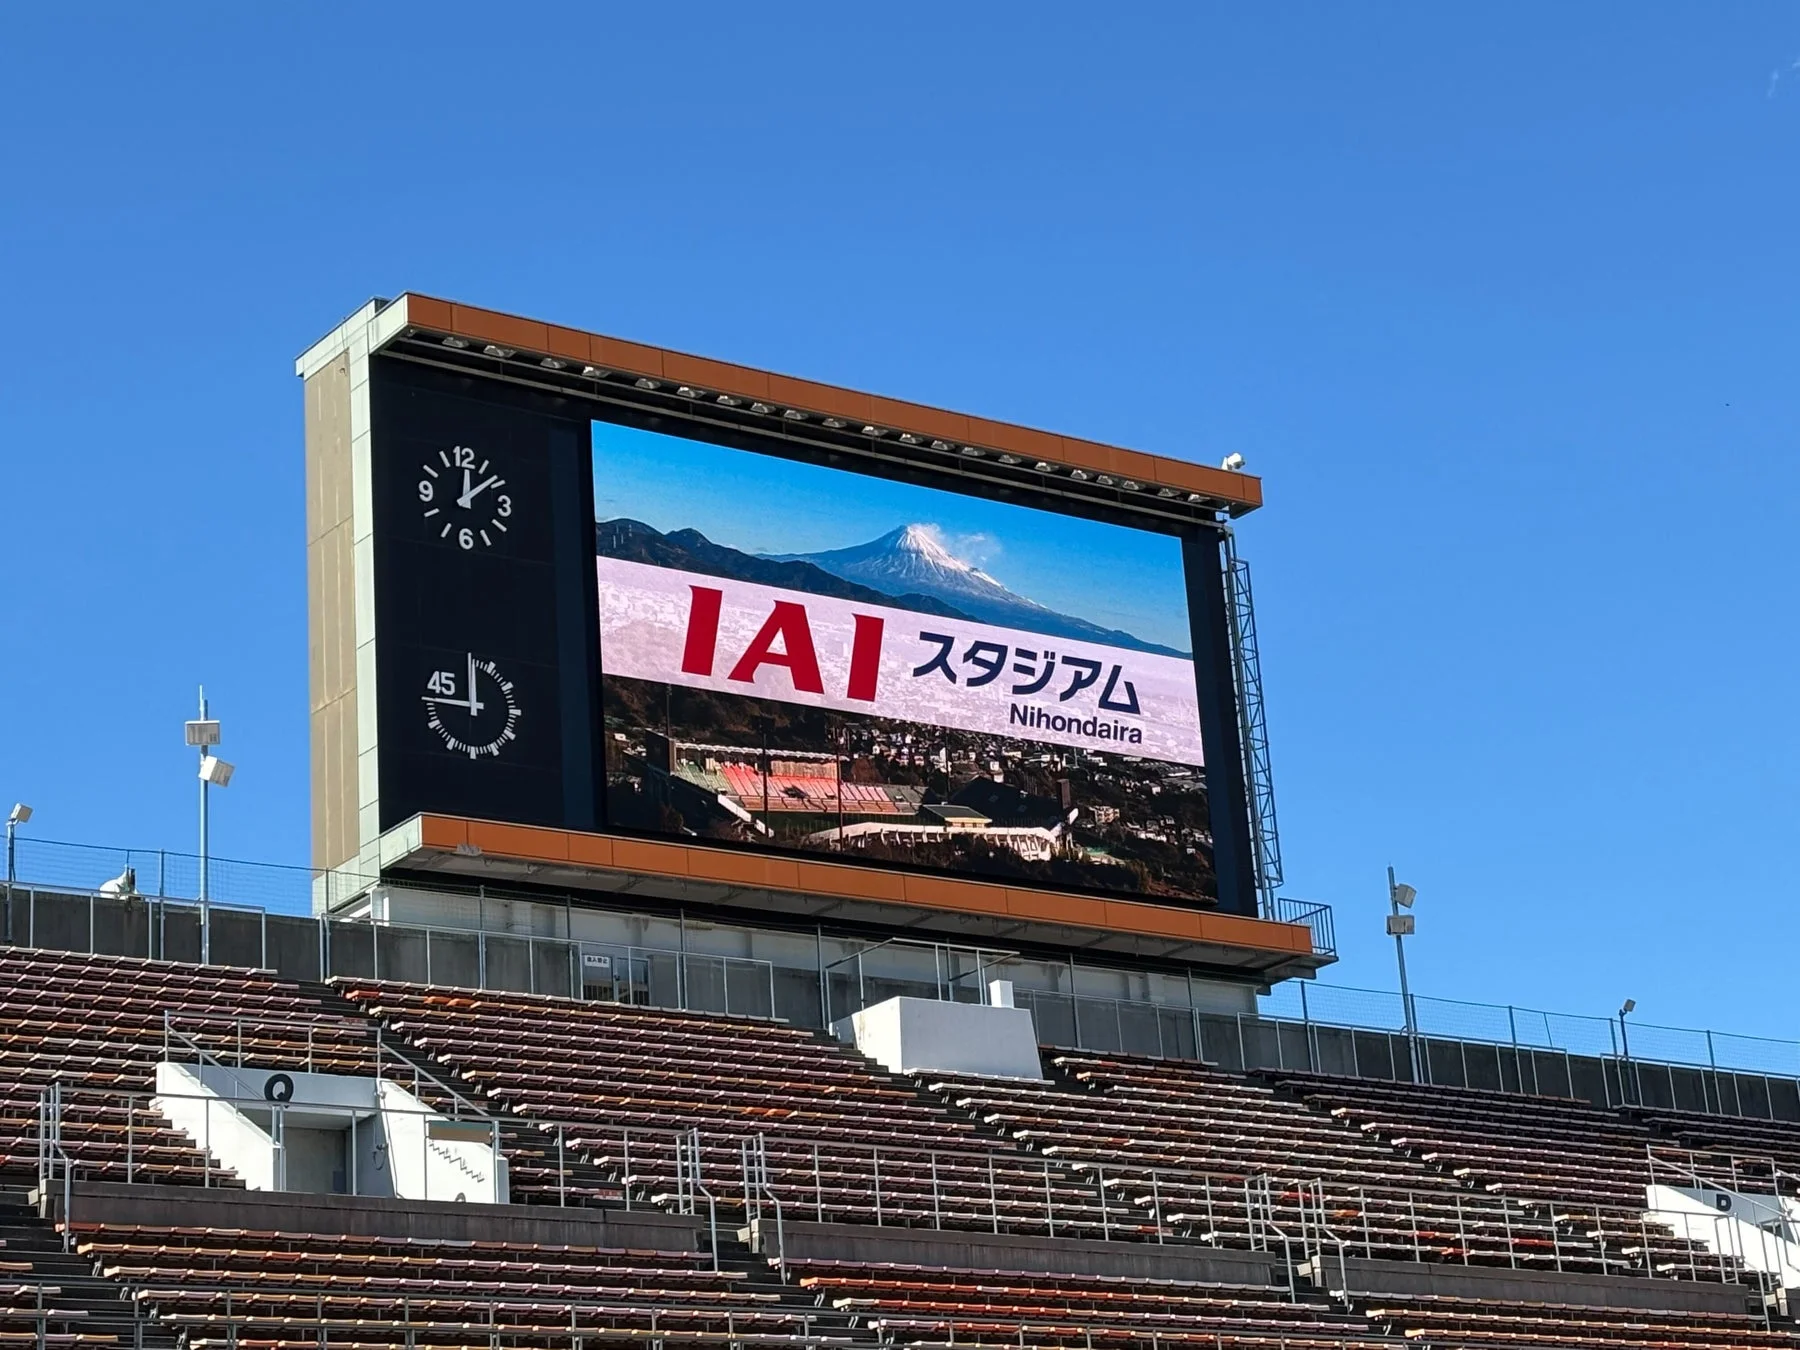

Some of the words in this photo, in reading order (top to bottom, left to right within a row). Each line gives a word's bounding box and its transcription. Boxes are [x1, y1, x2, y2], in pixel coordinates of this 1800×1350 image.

[453, 446, 476, 469] 12
[418, 480, 434, 502] 9
[497, 495, 512, 517] 3
[458, 528, 474, 550] 6
[681, 585, 884, 702] IAI
[912, 631, 1141, 715] スタジアム
[427, 671, 456, 695] 45
[1009, 704, 1143, 744] Nihondaira
[264, 1073, 294, 1108] Q
